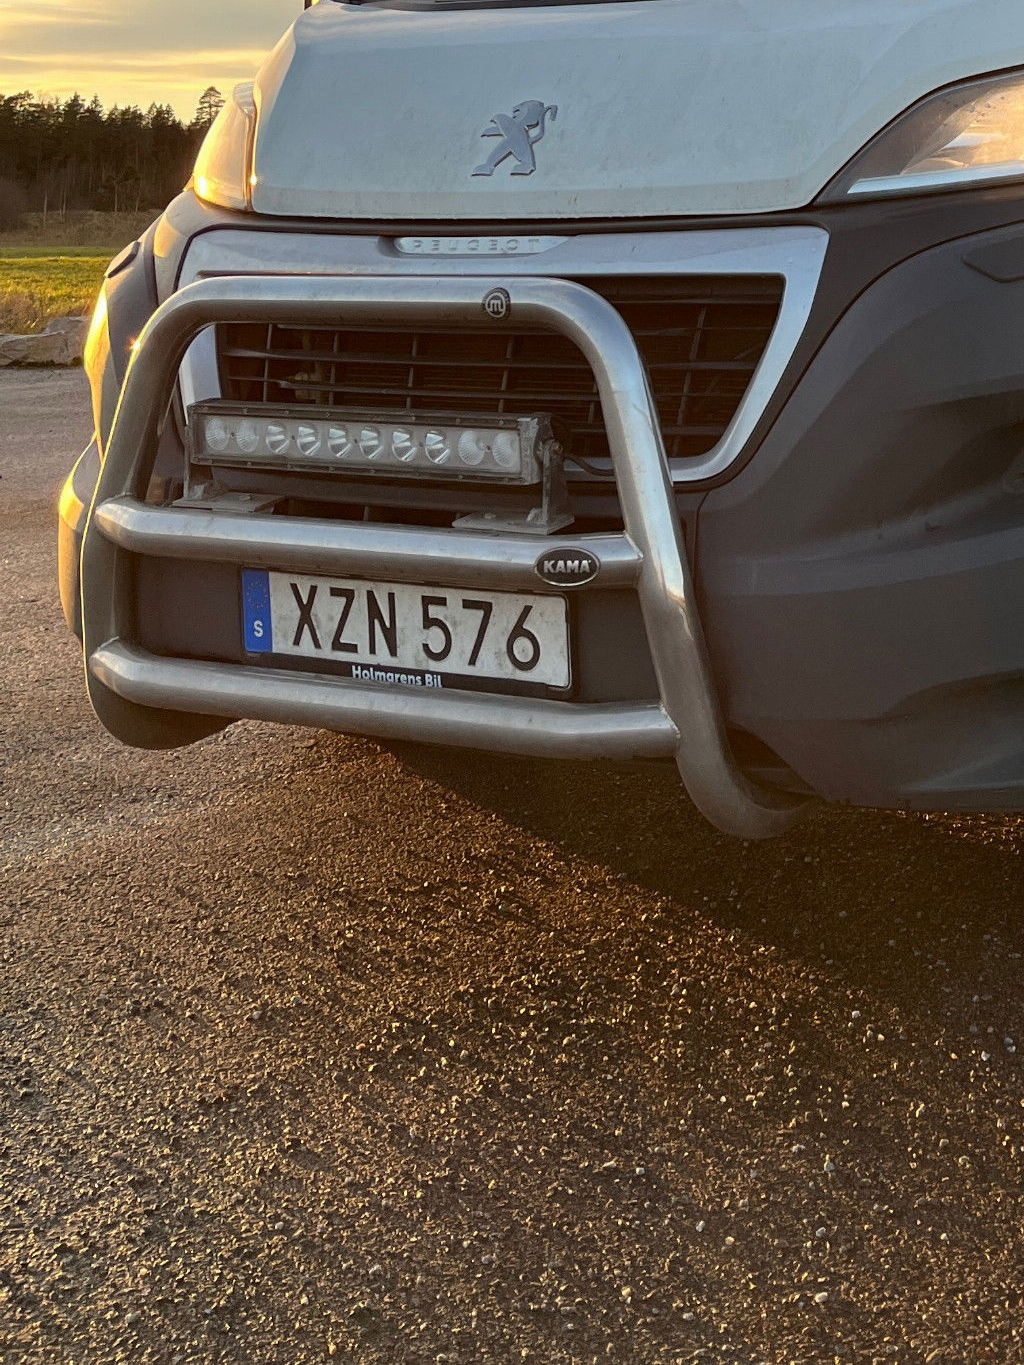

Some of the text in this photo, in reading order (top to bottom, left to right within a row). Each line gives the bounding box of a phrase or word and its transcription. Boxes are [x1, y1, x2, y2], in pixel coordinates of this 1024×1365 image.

[411, 238, 540, 252] PEUGEOT
[543, 559, 591, 574] KAMA
[253, 620, 264, 638] S
[289, 582, 541, 672] XZN 576
[424, 673, 443, 688] Bil
